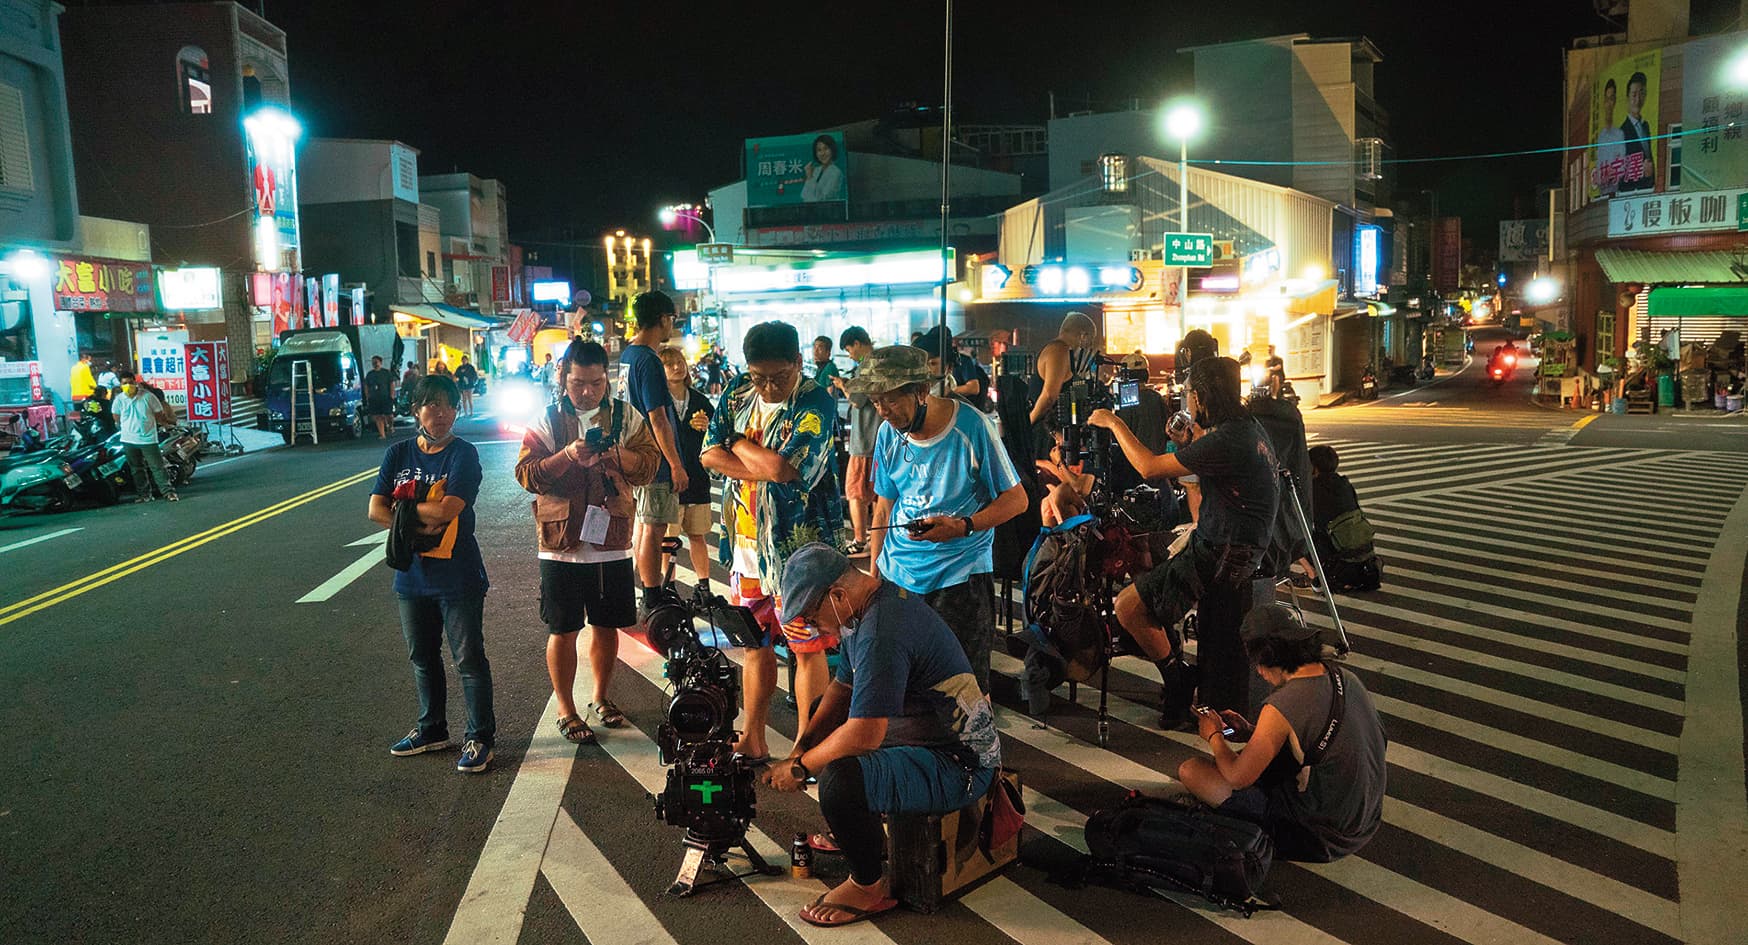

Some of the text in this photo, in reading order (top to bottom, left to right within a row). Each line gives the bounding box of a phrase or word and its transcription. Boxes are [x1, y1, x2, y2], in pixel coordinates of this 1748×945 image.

[758, 159, 803, 177] 周春米
[1642, 195, 1739, 229] 慢板咖
[1171, 238, 1206, 251] 中山路
[142, 357, 185, 374] 農會超市
[190, 346, 214, 417] 大富小吃
